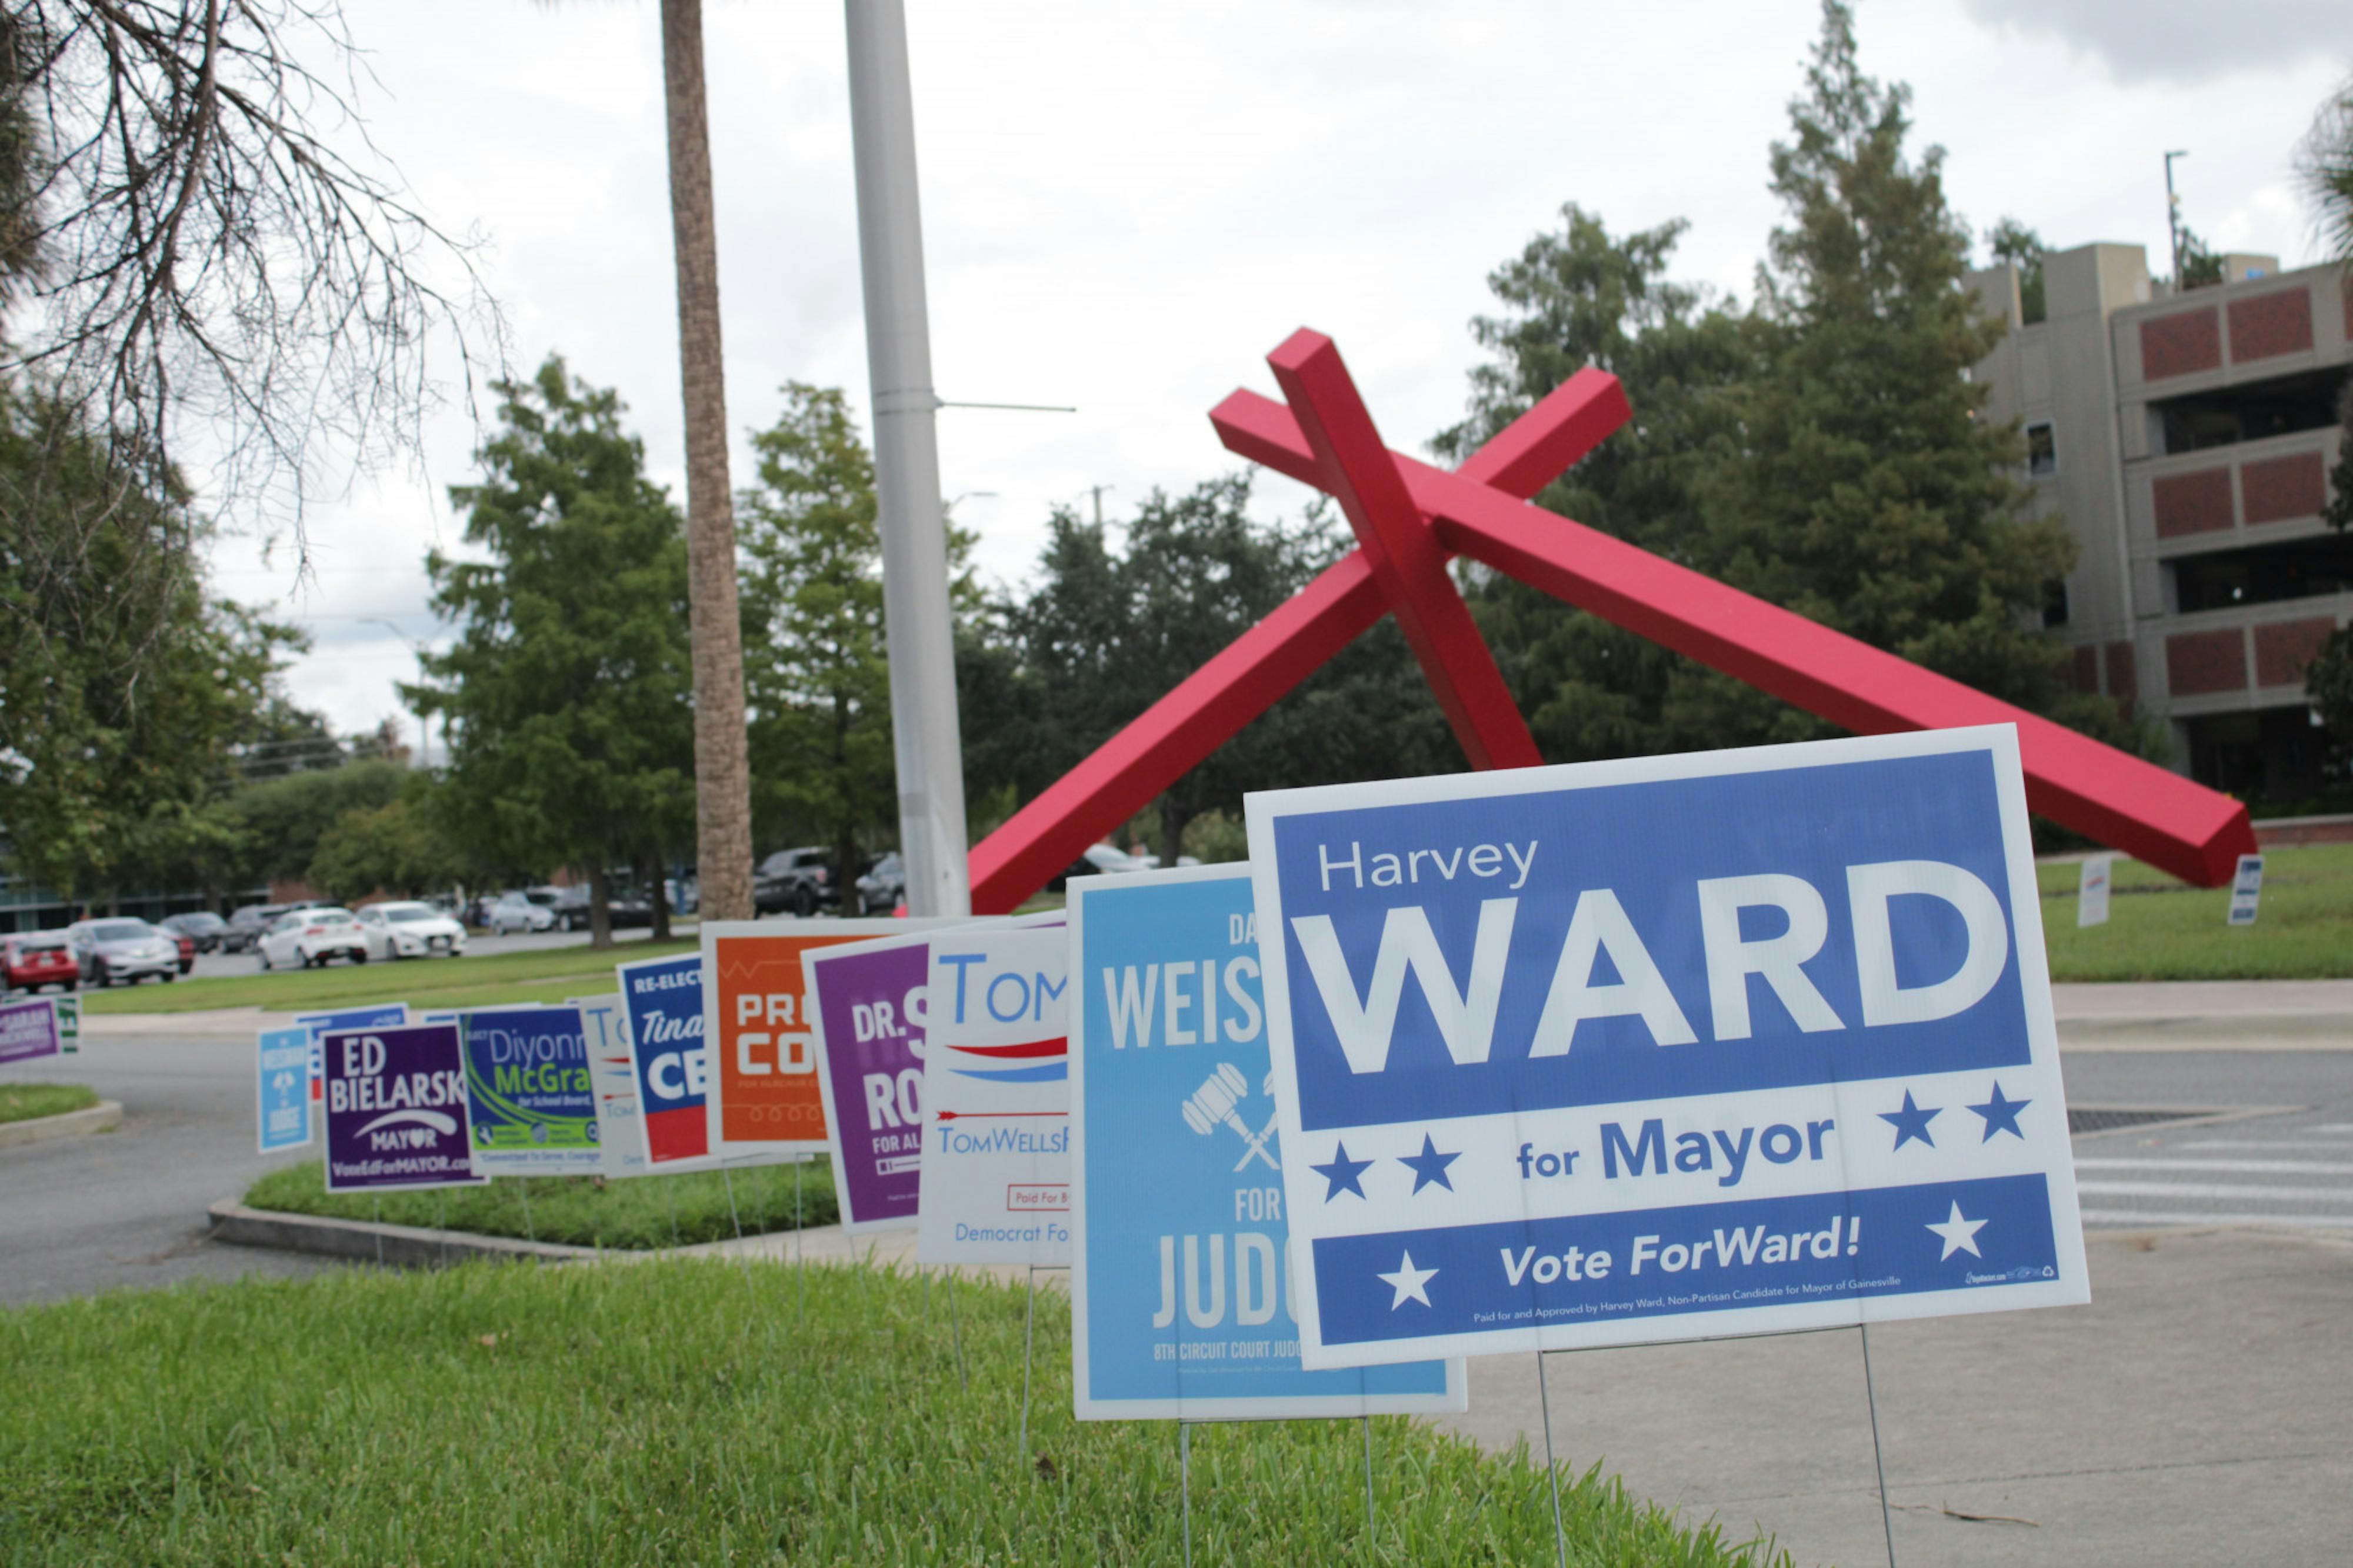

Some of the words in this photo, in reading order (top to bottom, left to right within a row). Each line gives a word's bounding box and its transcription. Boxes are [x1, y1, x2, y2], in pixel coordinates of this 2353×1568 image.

[1319, 840, 1538, 891] Harvey
[1229, 913, 1259, 945] DA
[1289, 859, 2008, 1075] WARD
[736, 993, 811, 1026] PR
[852, 1001, 906, 1043] DR.
[1102, 955, 1262, 1050] WEIS
[642, 1009, 705, 1045] Tina
[342, 1036, 386, 1077] ED
[736, 1032, 816, 1075] CO
[330, 1070, 465, 1112] BIELARSK
[494, 1063, 590, 1094] McGra
[863, 1068, 924, 1131] RO
[872, 1135, 901, 1154] FOR
[903, 1132, 921, 1150] AL
[1517, 1143, 1579, 1179] for
[1600, 1118, 1835, 1187] Mayor
[1016, 1192, 1038, 1203] Paid
[1042, 1192, 1058, 1203] For
[1235, 1187, 1281, 1222] FOR
[955, 1223, 1041, 1242] Democrat
[1048, 1223, 1069, 1242] Fo
[1500, 1246, 1612, 1286] Vote
[1630, 1216, 1861, 1275] ForWard!
[1152, 1232, 1299, 1329] JUD
[1474, 1312, 1495, 1323] Paid
[1498, 1311, 1511, 1320] for
[1514, 1310, 1532, 1319] and
[1535, 1305, 1583, 1318] Approved
[1585, 1303, 1597, 1315] by
[1600, 1300, 1634, 1312] Harvey
[1636, 1297, 1666, 1308] Ward,
[1668, 1292, 1730, 1306] Non-Partisan
[1732, 1287, 1783, 1300] Candidate
[1786, 1285, 1799, 1295] for
[1802, 1282, 1833, 1295] Mayor
[1836, 1279, 1847, 1290] of
[1848, 1275, 1901, 1289] Gainesville
[1154, 1343, 1175, 1362] 8TH
[1179, 1342, 1227, 1360] CIRCUIT
[1231, 1340, 1271, 1359] COURT
